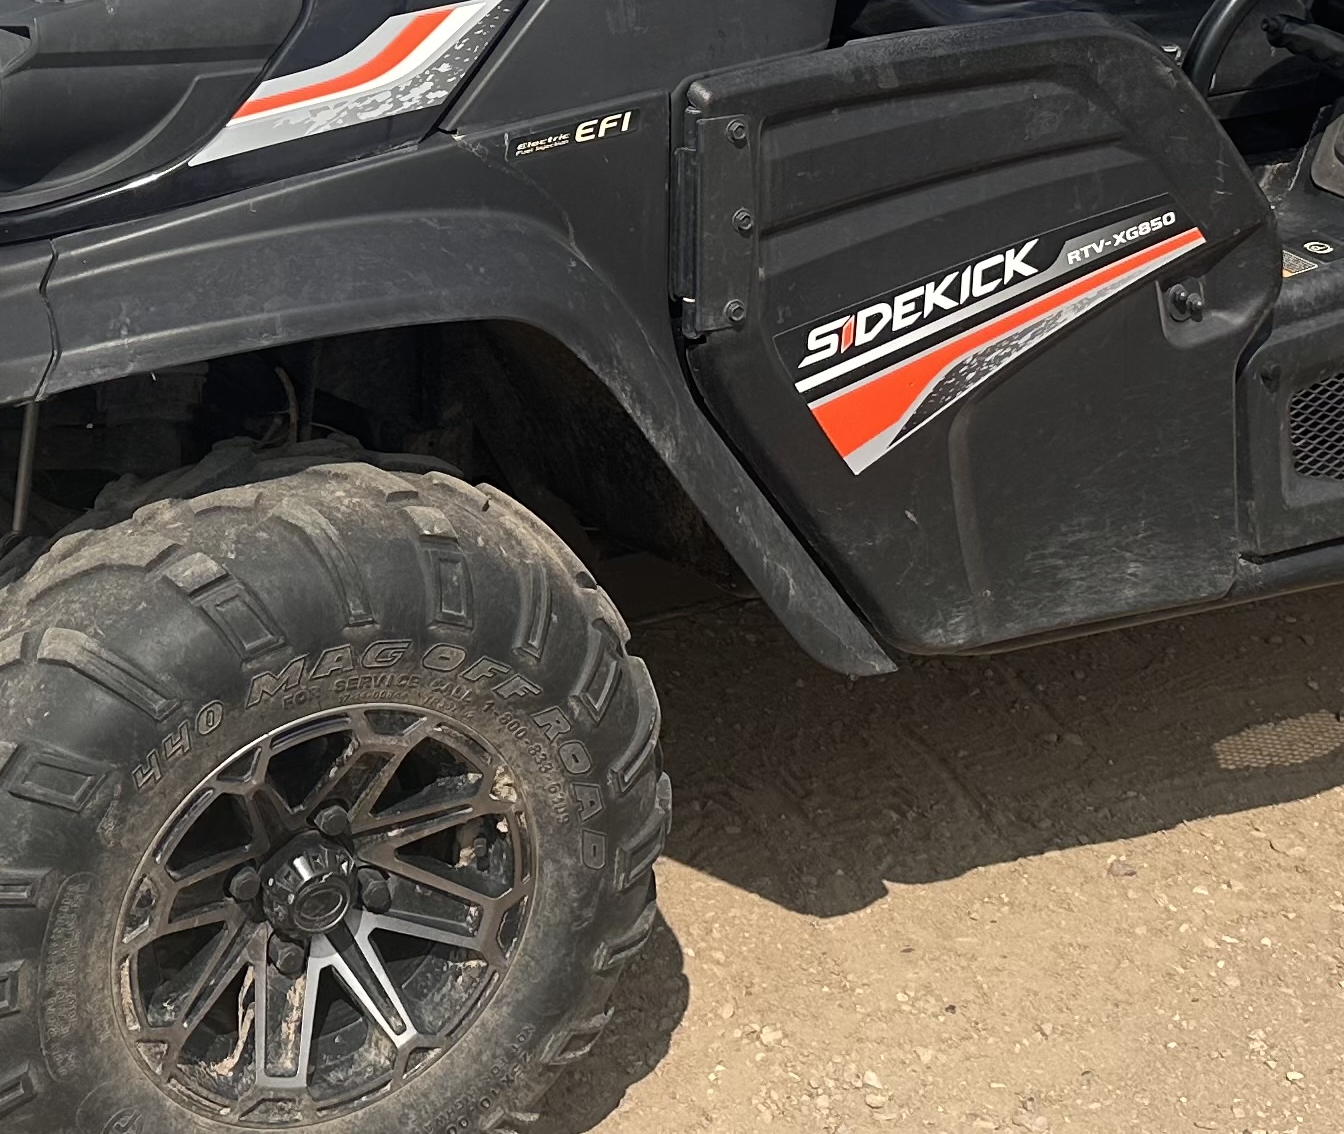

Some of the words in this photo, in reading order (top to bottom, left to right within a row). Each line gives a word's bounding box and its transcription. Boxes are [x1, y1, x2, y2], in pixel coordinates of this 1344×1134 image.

[574, 110, 632, 143] EFI
[798, 238, 1040, 369] SIDEKICK
[1066, 210, 1176, 266] RTV-XG850
[334, 672, 421, 693] SERVICE
[131, 699, 225, 791] 440
[244, 638, 413, 710] MAG
[421, 642, 543, 700] OFF
[529, 705, 608, 871] ROAD
